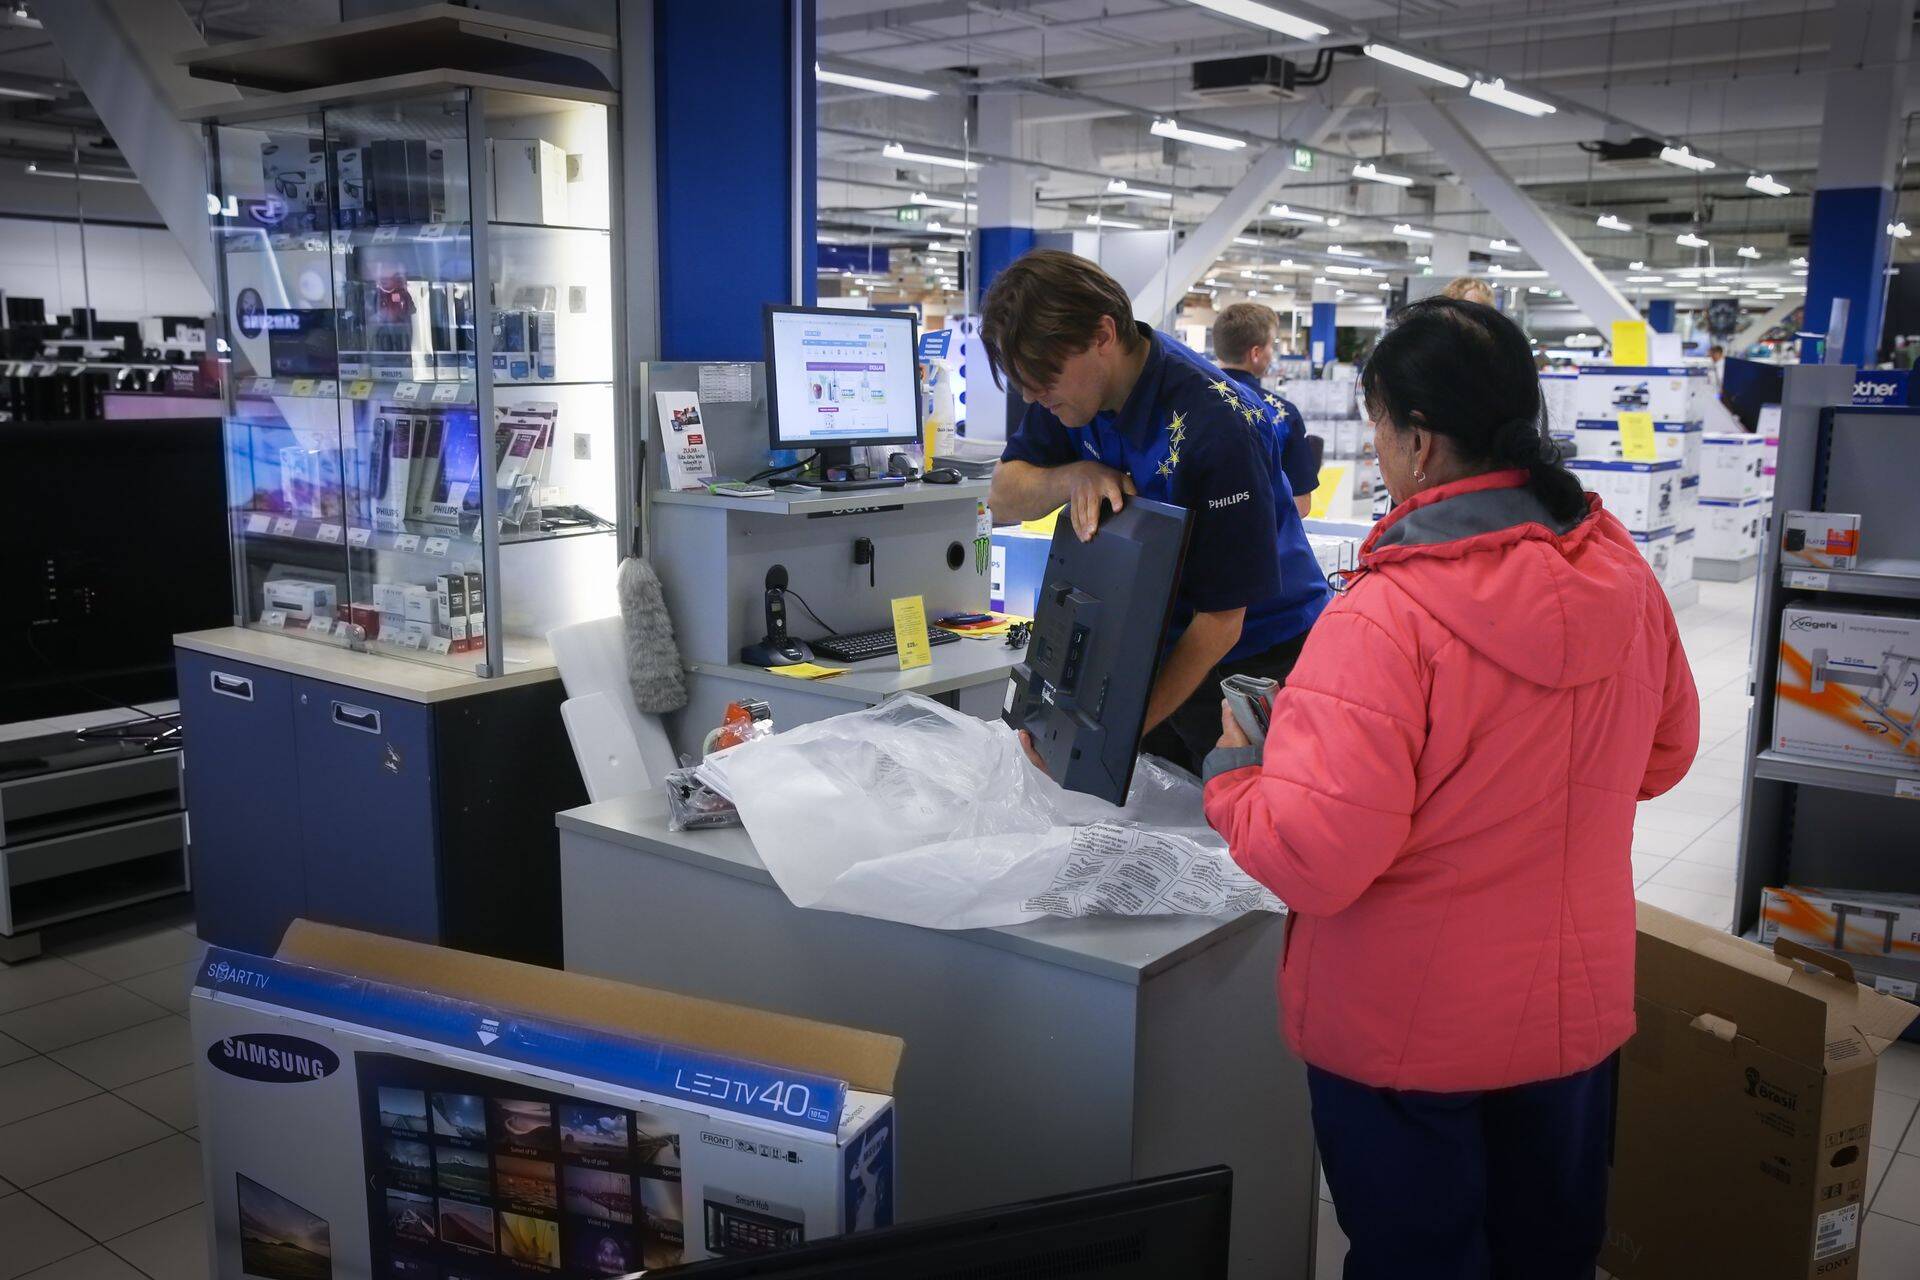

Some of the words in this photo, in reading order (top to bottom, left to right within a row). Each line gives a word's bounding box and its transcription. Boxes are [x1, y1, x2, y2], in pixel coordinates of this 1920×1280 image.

[1208, 491, 1250, 509] PHILIPS
[376, 507, 399, 517] PHILIPS
[433, 505, 458, 515] PHILIPS
[1798, 621, 1838, 629] vogel's
[208, 962, 255, 985] SMART
[255, 974, 270, 988] TV
[223, 1037, 324, 1080] SAMSUNG
[759, 1081, 810, 1117] 40
[1759, 1086, 1798, 1111] Brasil
[703, 1134, 730, 1146] FRONT
[736, 1195, 757, 1208] Smart
[756, 1200, 769, 1212] Hub
[1816, 1257, 1850, 1276] SONY
